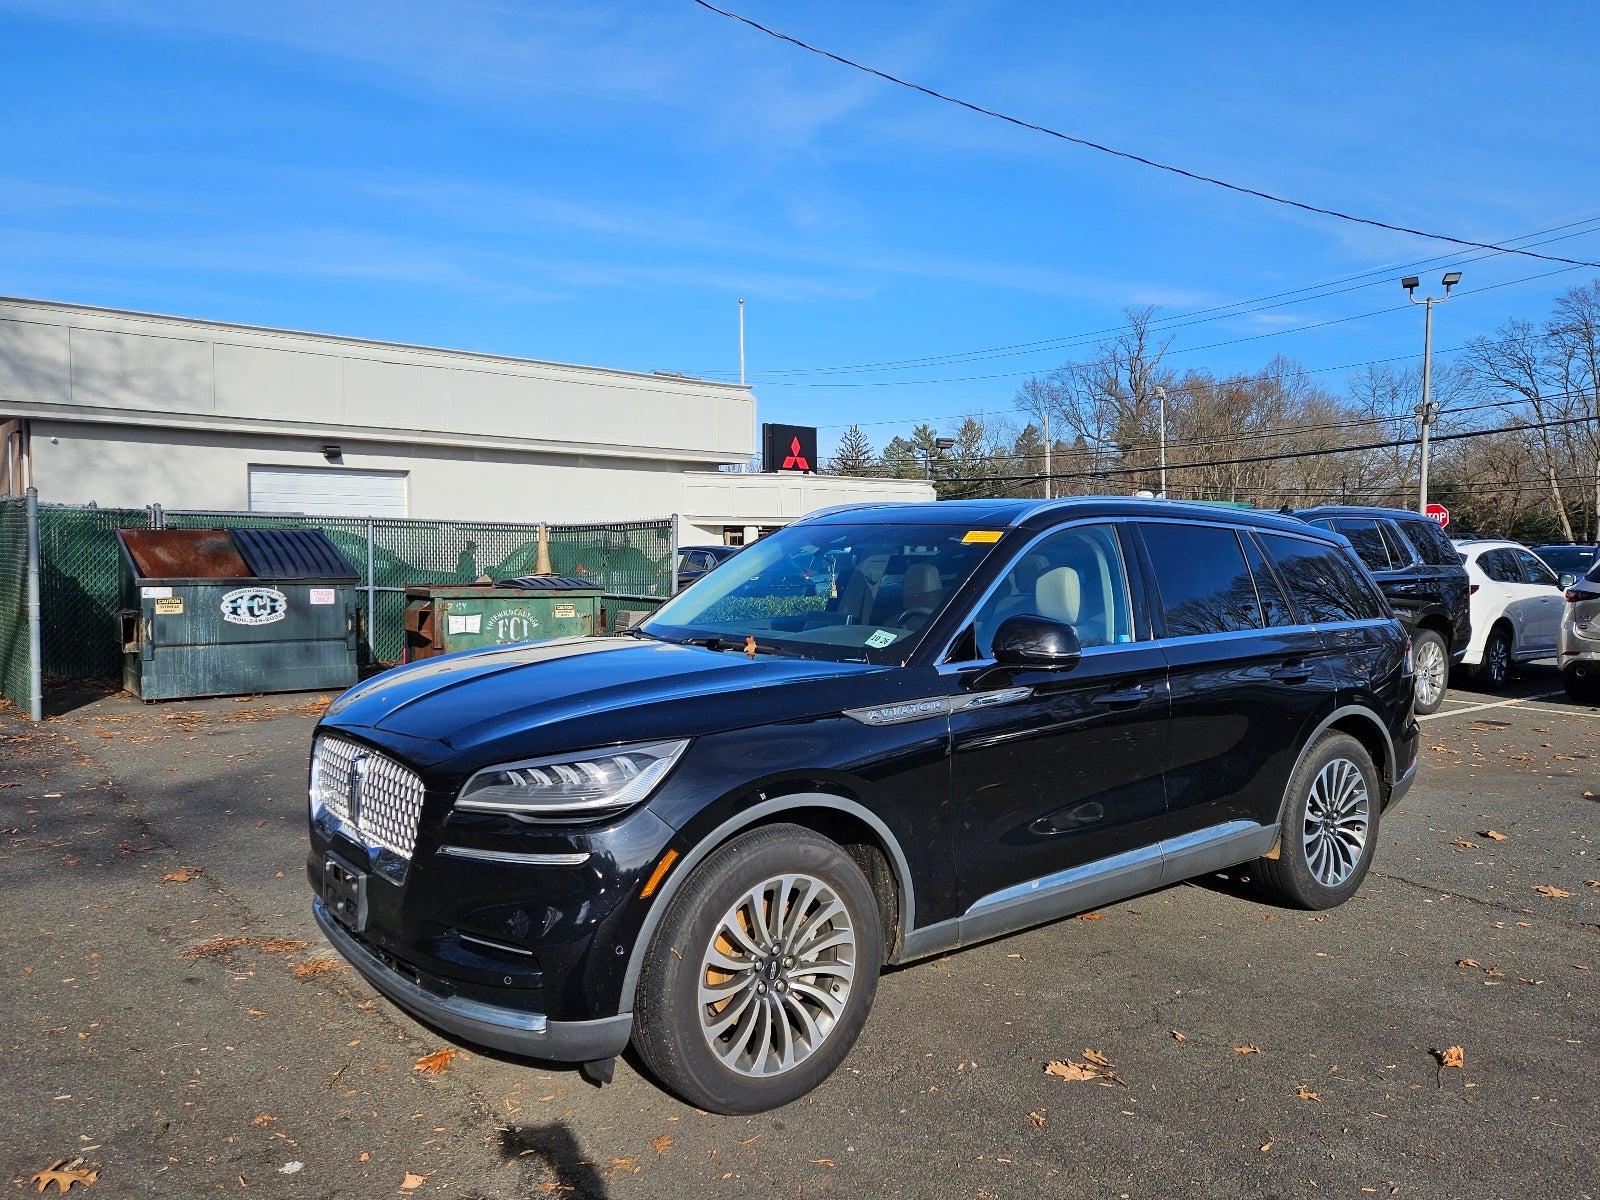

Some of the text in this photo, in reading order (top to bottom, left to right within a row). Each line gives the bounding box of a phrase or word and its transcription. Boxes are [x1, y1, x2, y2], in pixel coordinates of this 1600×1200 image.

[1427, 512, 1447, 523] TOP
[497, 617, 529, 641] FCI
[870, 702, 941, 720] AVIATOR
